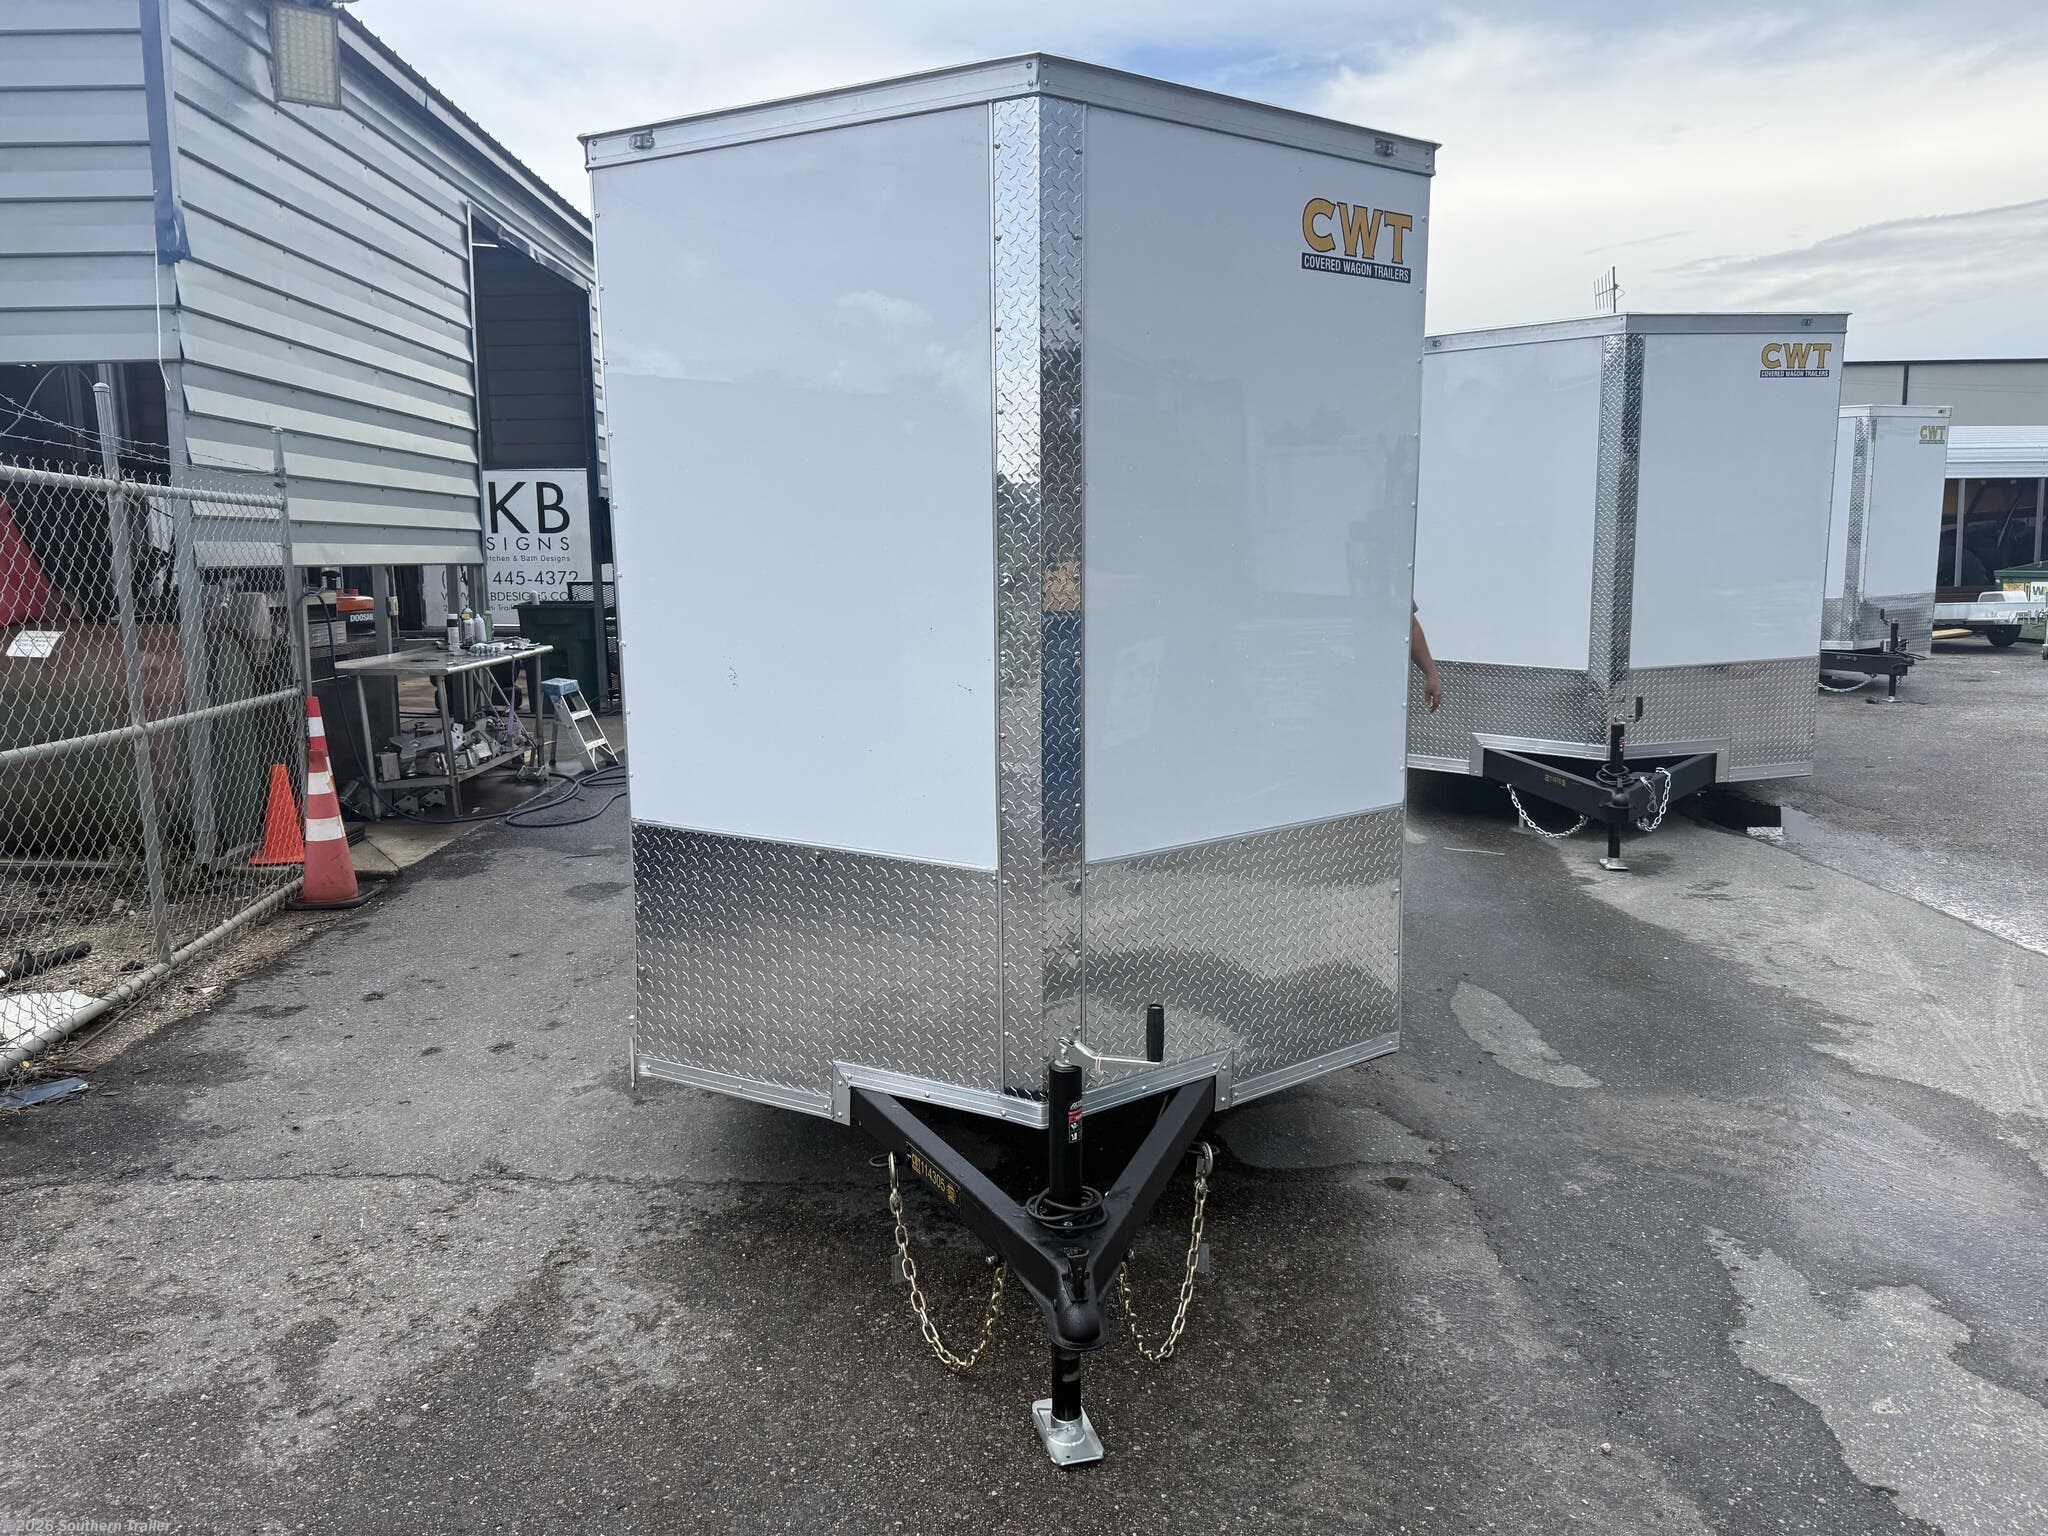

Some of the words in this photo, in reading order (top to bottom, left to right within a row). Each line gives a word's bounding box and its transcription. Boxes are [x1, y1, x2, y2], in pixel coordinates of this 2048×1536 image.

[1302, 197, 1413, 265] CWT
[1303, 254, 1341, 271] COVERED
[1342, 260, 1372, 276] WAGON
[1373, 265, 1410, 281] TRAILERS
[1761, 342, 1833, 369] CWT
[1785, 369, 1804, 377] WAGON
[1919, 425, 1946, 440] CWT
[488, 481, 570, 534] KB
[486, 536, 570, 551] SIGNS
